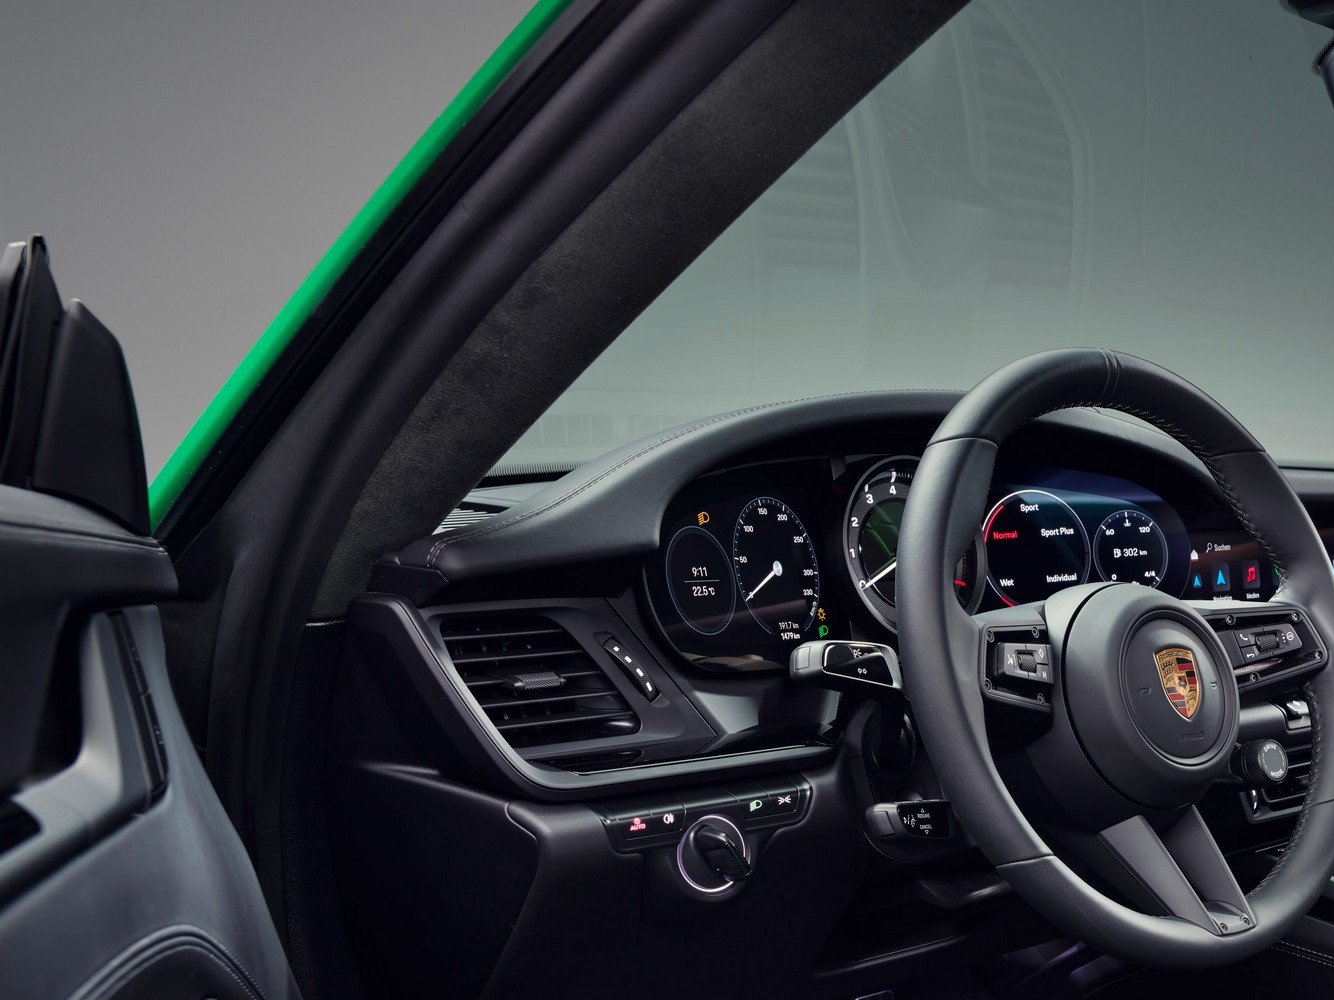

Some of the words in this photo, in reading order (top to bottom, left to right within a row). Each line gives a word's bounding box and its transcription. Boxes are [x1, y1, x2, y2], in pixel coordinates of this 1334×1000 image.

[889, 485, 897, 495] 4
[865, 494, 874, 504] 3
[1020, 503, 1039, 513] Sport
[850, 517, 859, 527] 2
[993, 530, 1018, 540] Normal
[1040, 528, 1059, 538] Sport
[1060, 527, 1074, 535] Plus
[1123, 548, 1139, 557] 302
[1213, 543, 1232, 552] Suchen
[849, 548, 855, 558] 1
[691, 566, 708, 577] 9:11
[1144, 570, 1156, 578] 4/4
[1000, 578, 1014, 587] Wet
[1046, 573, 1077, 583] Individual
[692, 586, 708, 597] 22.5
[778, 622, 792, 630] 191.7
[780, 632, 793, 640] 1479
[1263, 743, 1276, 752] DRIVE
[1271, 769, 1283, 777] MODE
[630, 823, 646, 831] AUTO
